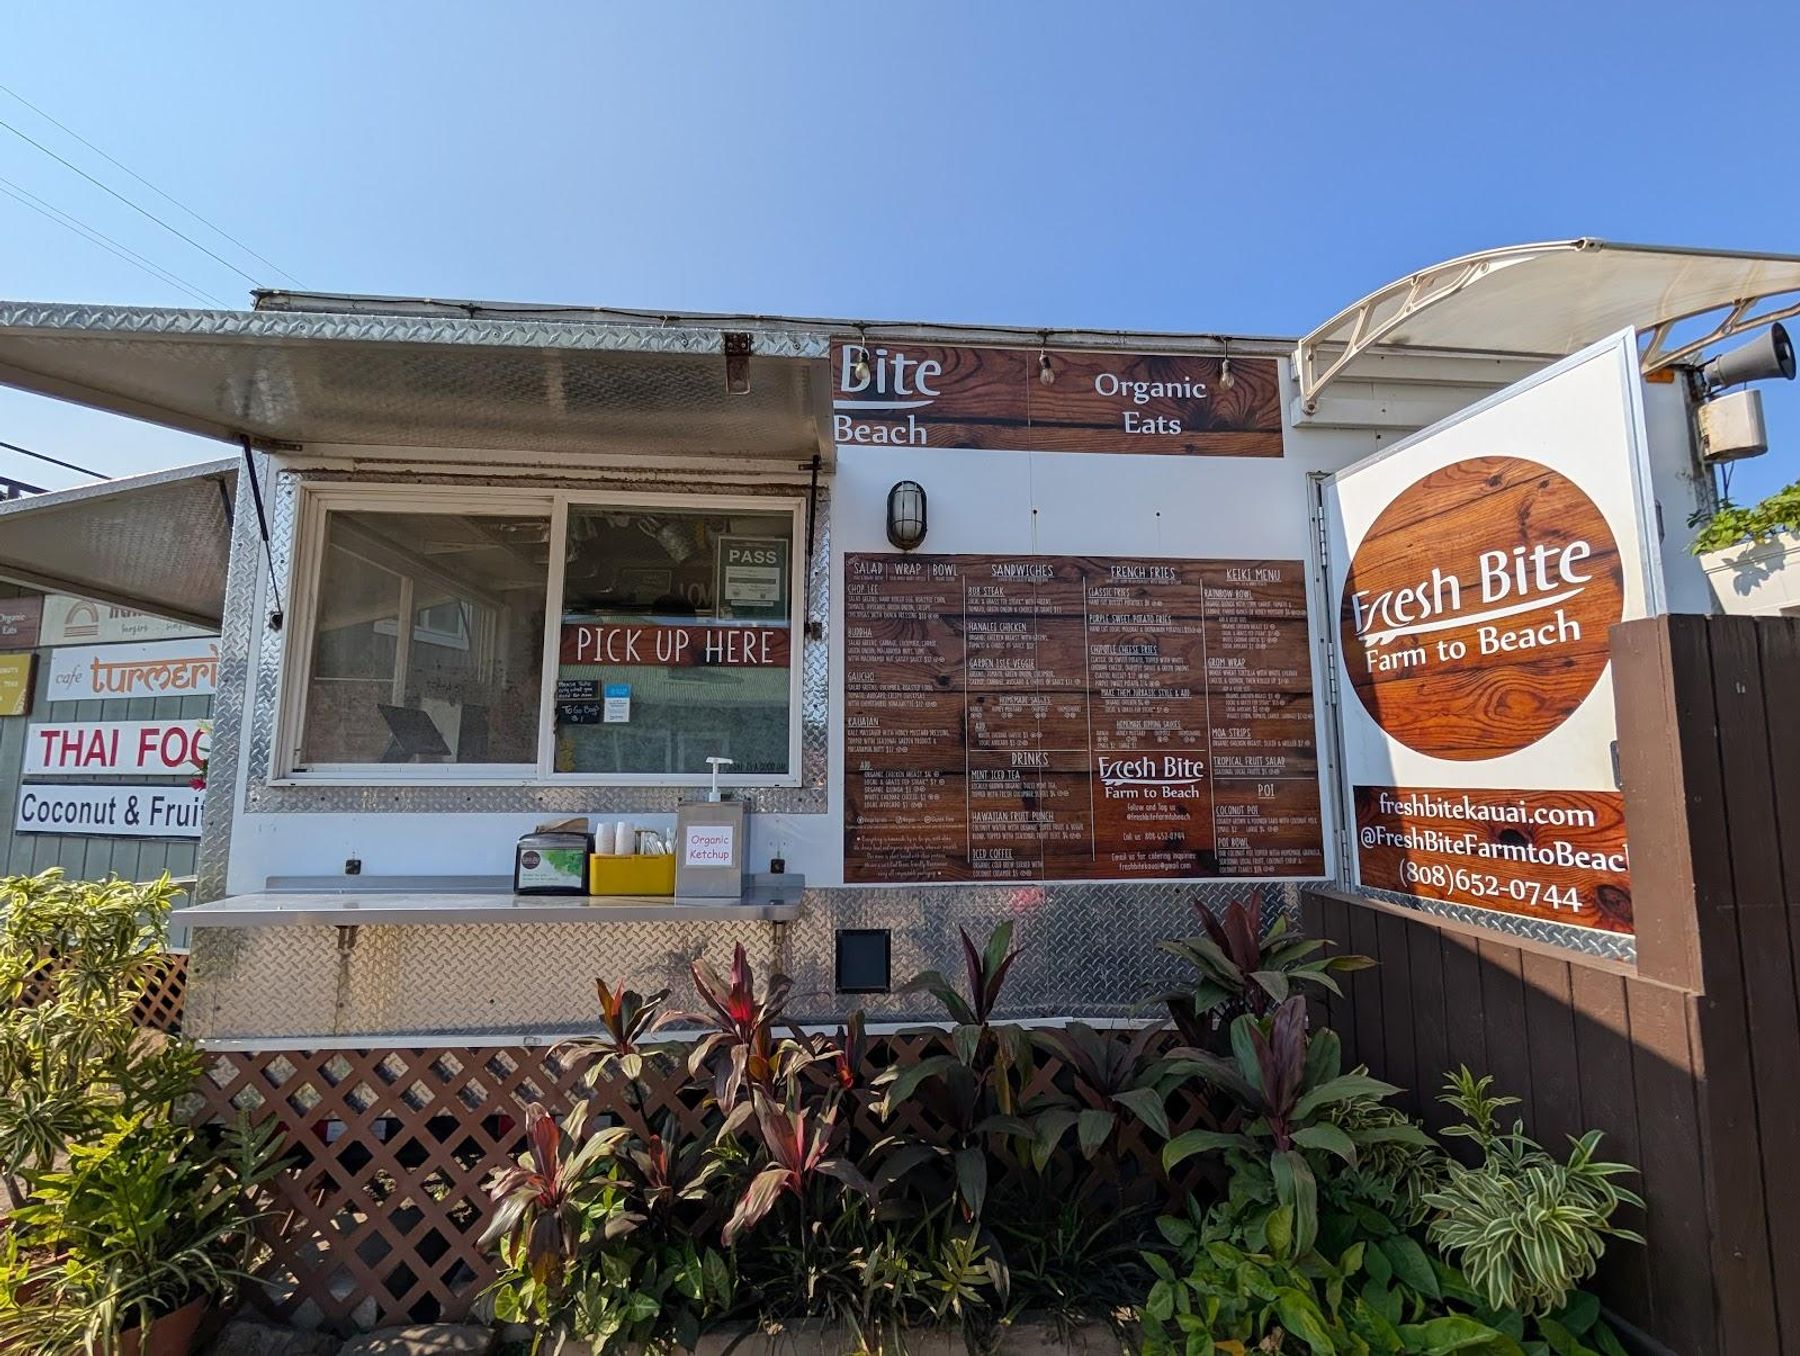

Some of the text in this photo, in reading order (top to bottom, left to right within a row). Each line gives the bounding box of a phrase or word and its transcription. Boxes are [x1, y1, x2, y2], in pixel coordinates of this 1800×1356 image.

[841, 345, 941, 396] Bite
[1095, 373, 1206, 403] Organic
[1122, 411, 1181, 436] Eats
[834, 415, 927, 445] Beach
[729, 549, 777, 564] PASS
[854, 562, 959, 577] SALAD WRAP BOWL
[992, 564, 1054, 576] SANDWICHES
[1111, 566, 1176, 579] FRENCH FRIES
[1226, 569, 1281, 581] KEIKI MENU
[984, 586, 1004, 596] STEAK
[1089, 588, 1130, 597] CLASSIC FRIES
[1352, 568, 1461, 634] Fresh
[1479, 540, 1592, 604] Bite
[1204, 589, 1252, 598] RAINBOW BOWL
[968, 622, 1027, 632] HANALEI CHICKEN
[577, 627, 775, 664] PICK UP HERE
[1365, 609, 1581, 673] Farm to Beach
[1013, 659, 1035, 669] VEGGIE
[1227, 658, 1246, 667] WRAP
[1211, 728, 1251, 737] MOA STRIPS
[40, 729, 119, 767] THAI
[1011, 752, 1049, 765] DRINKS
[1213, 756, 1286, 766] TROPICAL FRUIT SALAD
[1099, 756, 1204, 778] Fresh Bite
[971, 769, 1020, 780] MINT ICED TEA
[1105, 785, 1199, 798] Farm to Beach
[1257, 784, 1275, 796] POI
[21, 794, 116, 825] Coconut
[124, 795, 140, 826] &
[1127, 803, 1144, 811] Follow
[1216, 805, 1259, 815] COCONUT POI
[1380, 792, 1595, 827] freshbitekauai.com
[972, 811, 1054, 821] HAWAIIAN FRUIT PUNCH
[691, 834, 729, 849] Organic
[1231, 838, 1249, 847] BOWL
[689, 849, 729, 861] Ketchup
[973, 849, 1013, 859] ICED COFFEE
[1399, 858, 1582, 913] (808)652-0744
